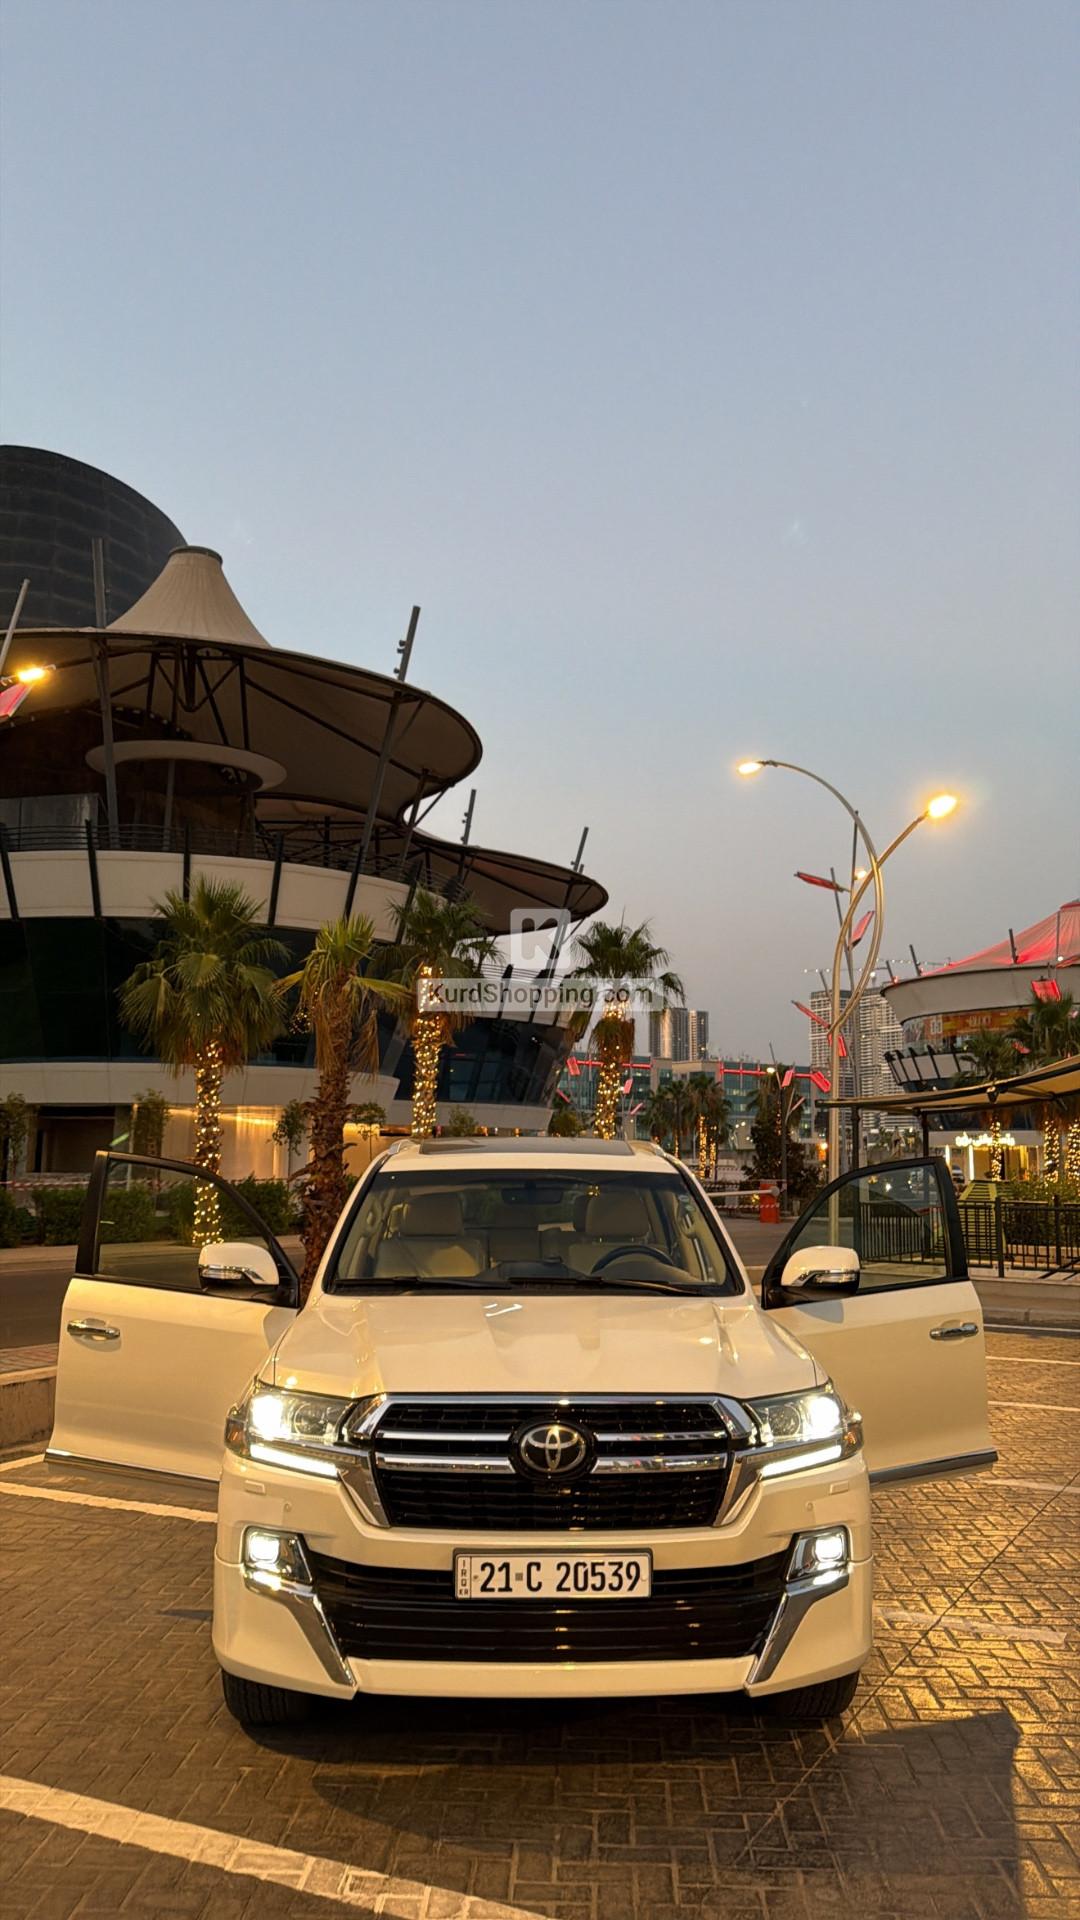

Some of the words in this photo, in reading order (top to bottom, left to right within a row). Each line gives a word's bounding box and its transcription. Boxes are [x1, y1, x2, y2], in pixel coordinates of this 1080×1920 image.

[480, 1561, 513, 1592] 21
[526, 1561, 543, 1592] C
[555, 1561, 641, 1592] 20539
